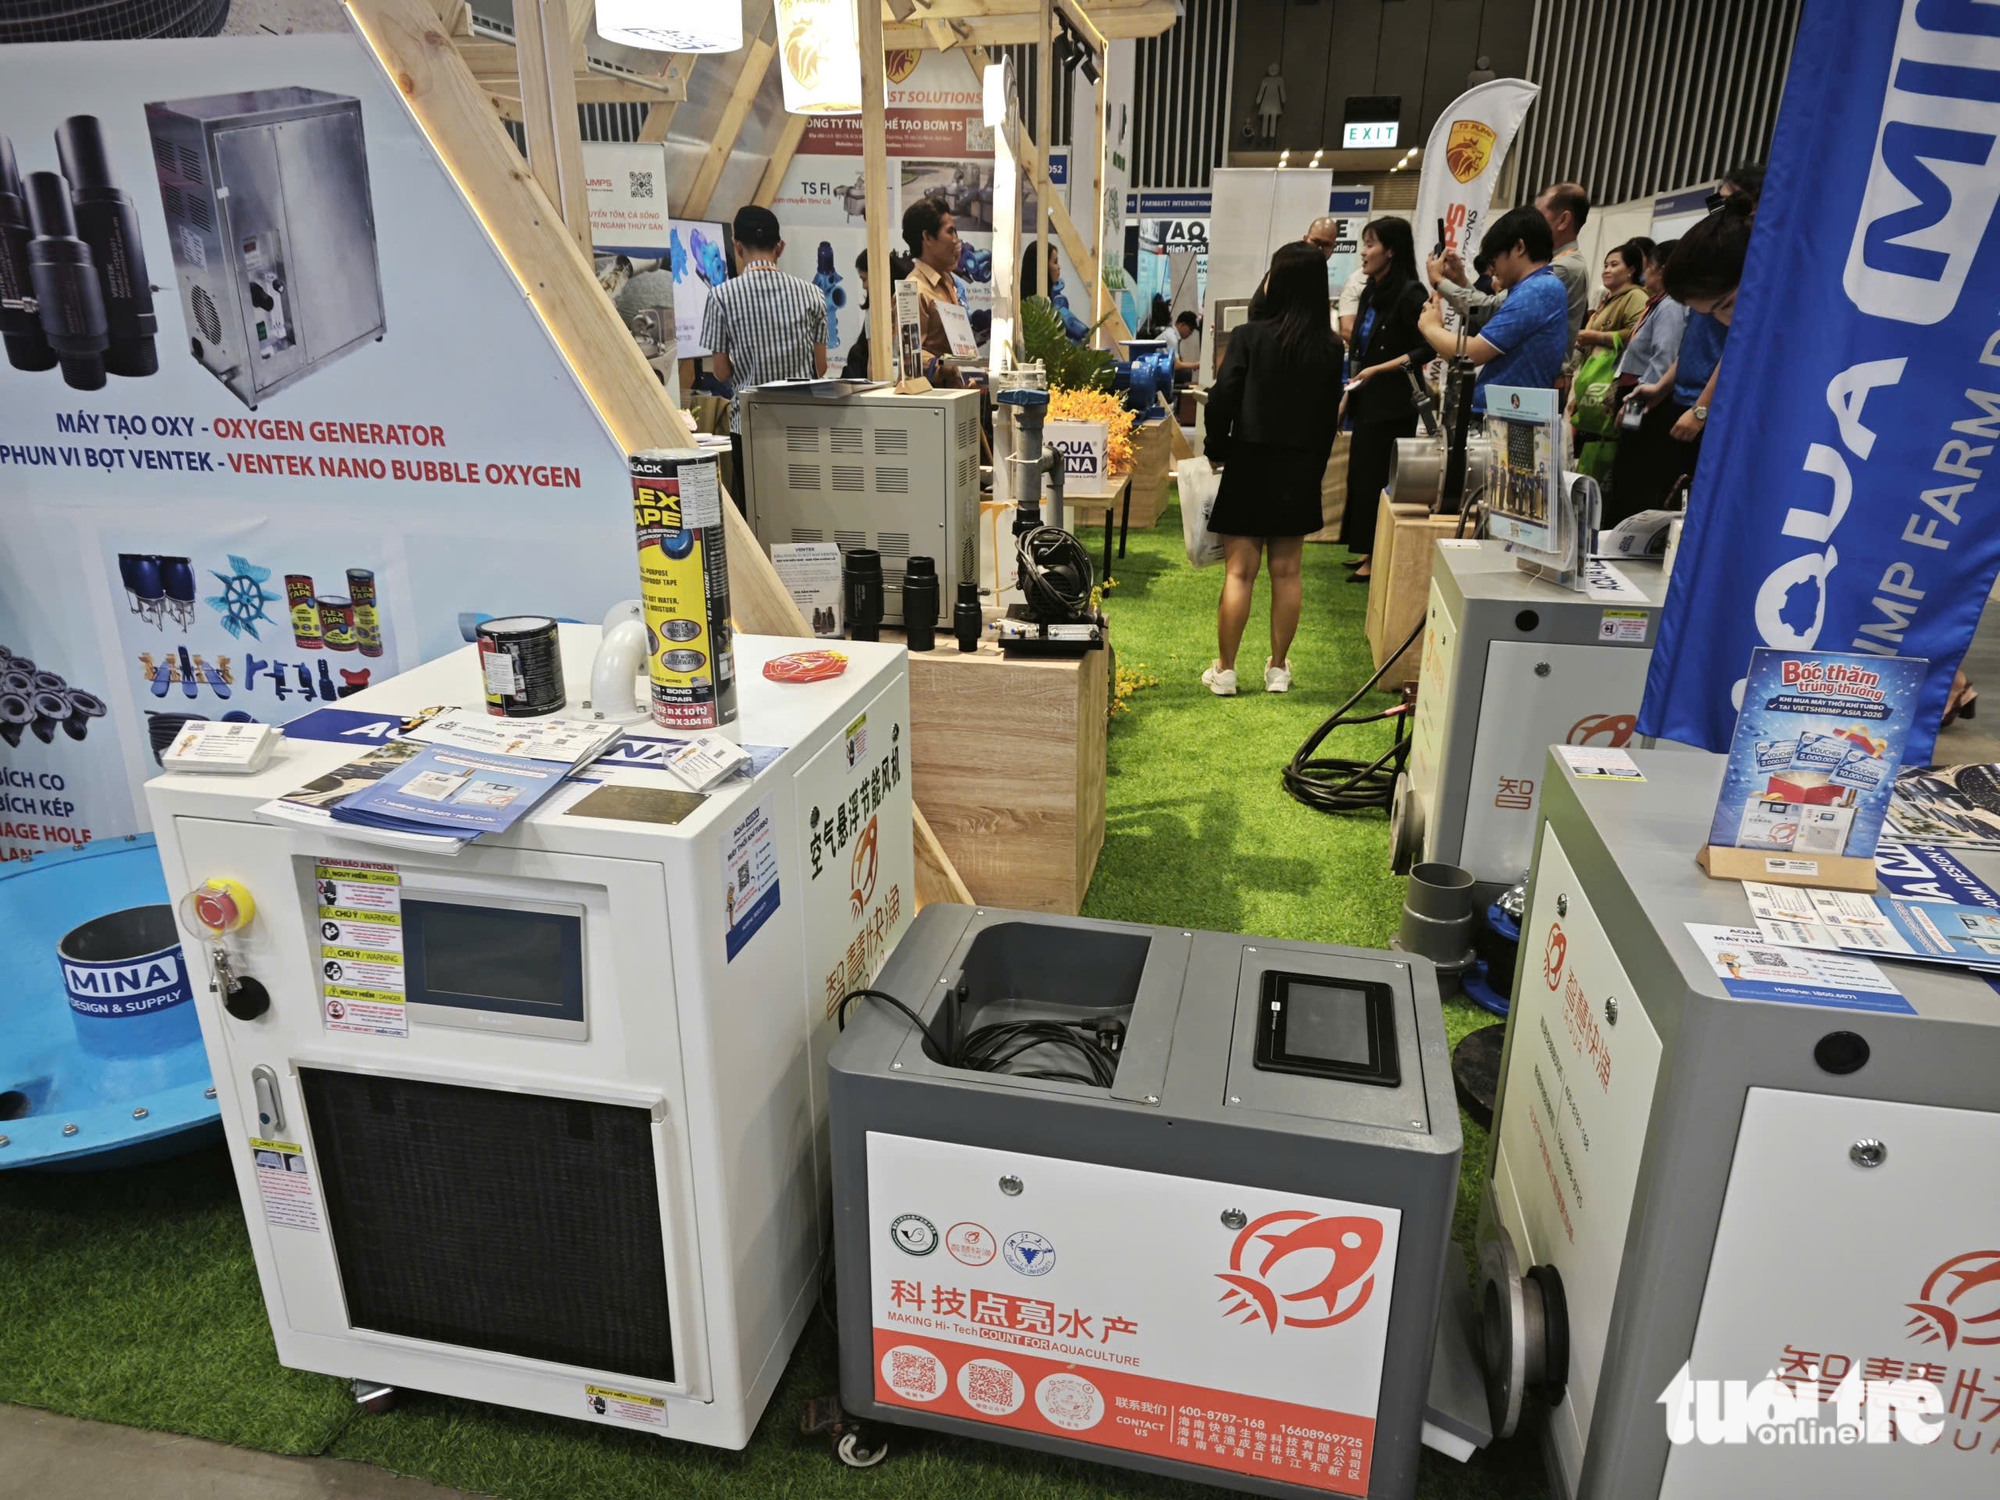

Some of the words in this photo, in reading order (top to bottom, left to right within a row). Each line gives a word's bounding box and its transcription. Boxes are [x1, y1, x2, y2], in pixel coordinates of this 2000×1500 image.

[908, 91, 983, 104] SOLUTIONS
[830, 119, 843, 129] TY
[900, 120, 921, 132] TẠO
[923, 119, 949, 131] BƠM
[950, 121, 963, 131] TS
[1350, 127, 1394, 140] EXIT
[802, 182, 817, 195] TS
[1141, 200, 1171, 208] FARMAVET
[1166, 245, 1185, 254] High
[1187, 245, 1206, 254] Tech
[56, 410, 100, 434] MÁY
[103, 415, 147, 441] TẠO
[151, 416, 195, 437] OXY
[213, 418, 304, 442] OXYGEN
[309, 422, 446, 447] GENERATOR
[58, 447, 82, 467] VI
[86, 448, 125, 473] BỌT
[128, 449, 214, 472] VENTEK
[227, 453, 313, 476] VENTEK
[319, 457, 386, 480] NANO
[391, 460, 481, 484] BUBBLE
[485, 463, 582, 489] OXYGEN
[288, 582, 311, 591] FLEX
[289, 589, 311, 599] TAPE
[321, 609, 344, 618] FLEX
[323, 616, 345, 624] TAPE
[1783, 661, 1822, 684] Bốc
[1826, 664, 1879, 686] thăm
[1798, 680, 1836, 695] trúng
[1837, 682, 1884, 701] thưởng
[697, 706, 708, 716] ft)
[1792, 705, 1841, 714] VIETSHRIMP
[703, 717, 713, 725] m)
[1810, 746, 1842, 757] VOUCHER
[1849, 764, 1880, 777] VOUCHER
[39, 774, 65, 791] CO
[1494, 775, 1534, 810] 智
[41, 797, 75, 818] KÉP
[810, 745, 901, 881] 空气悬浮节能风机
[733, 822, 747, 837] AQUA
[754, 817, 769, 836] TURBO
[360, 861, 372, 869] AN
[335, 909, 351, 918] CHÚ
[363, 913, 396, 923] WARNING
[338, 948, 355, 958] CHÚ
[365, 953, 398, 962] WARNING
[70, 963, 171, 994] MINA
[340, 989, 358, 997] NGUY
[379, 994, 401, 1002] DANGER
[1774, 987, 1811, 995] Hotline:
[112, 1003, 123, 1013] &
[126, 989, 182, 1011] SUPPLY
[890, 1279, 1139, 1344] 科技点亮水产
[888, 1311, 932, 1328] MAKING
[953, 1323, 978, 1336] Tech
[981, 1328, 1022, 1346] COUNT
[1024, 1336, 1049, 1349] FOR
[1051, 1341, 1140, 1367] AQUACULTURE
[1115, 1396, 1167, 1416] 联系我们
[1116, 1416, 1165, 1432] CONTACT
[1178, 1405, 1265, 1429] 400-8787-168
[1279, 1423, 1363, 1448] 16608969725
[1135, 1428, 1148, 1437] US
[1178, 1416, 1363, 1460] 海南快渔生物科技有限公司
[1177, 1426, 1362, 1470] 海南点渔成金科技有限公司
[1176, 1436, 1361, 1481] 海南省海口市江东新区
